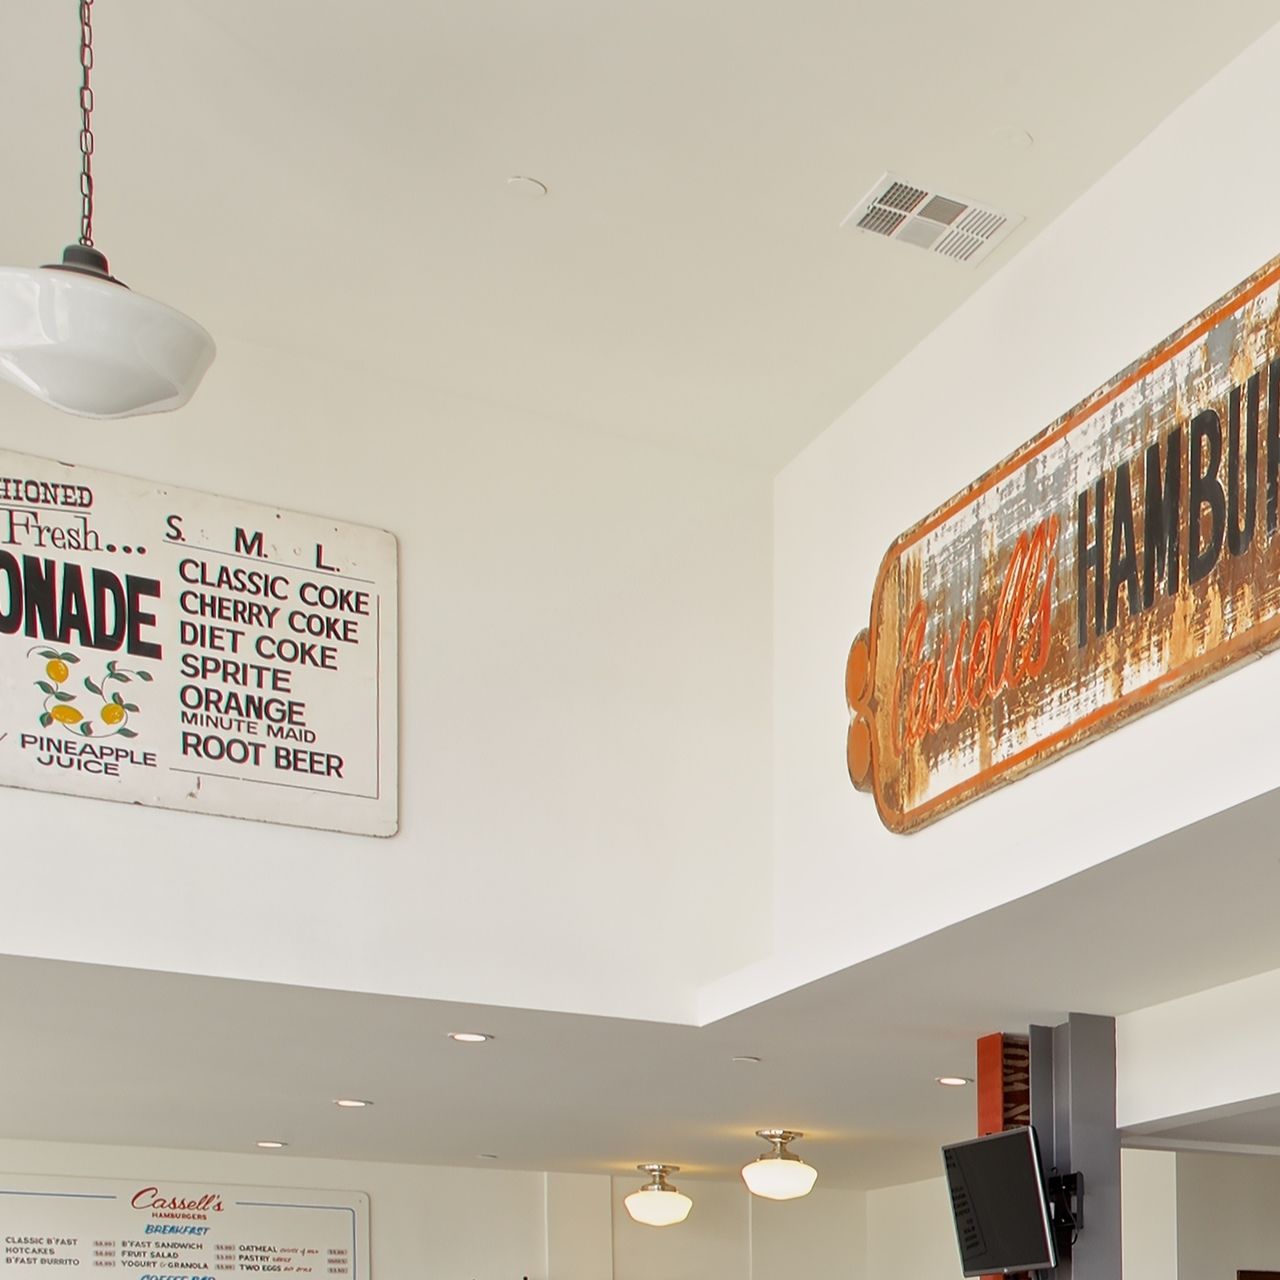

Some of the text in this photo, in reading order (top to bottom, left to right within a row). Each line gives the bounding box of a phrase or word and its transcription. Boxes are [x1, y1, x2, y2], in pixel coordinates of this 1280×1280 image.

[166, 515, 340, 572] S. M. L.
[179, 558, 369, 616] CLASSIC COKE
[180, 590, 358, 643] CHERRY COKE
[180, 620, 337, 670] DIET COKE
[180, 653, 291, 693] SPRITE
[180, 684, 306, 726] ORANGE
[181, 711, 316, 744] MINUTE MAID
[20, 733, 157, 767] PINEAPPLE
[36, 756, 119, 776] JUICE
[181, 731, 344, 778] ROOT BEER
[131, 1187, 224, 1211] Cassell's
[145, 1225, 210, 1236] BREAKFAST
[155, 1242, 203, 1250] SANDWICH
